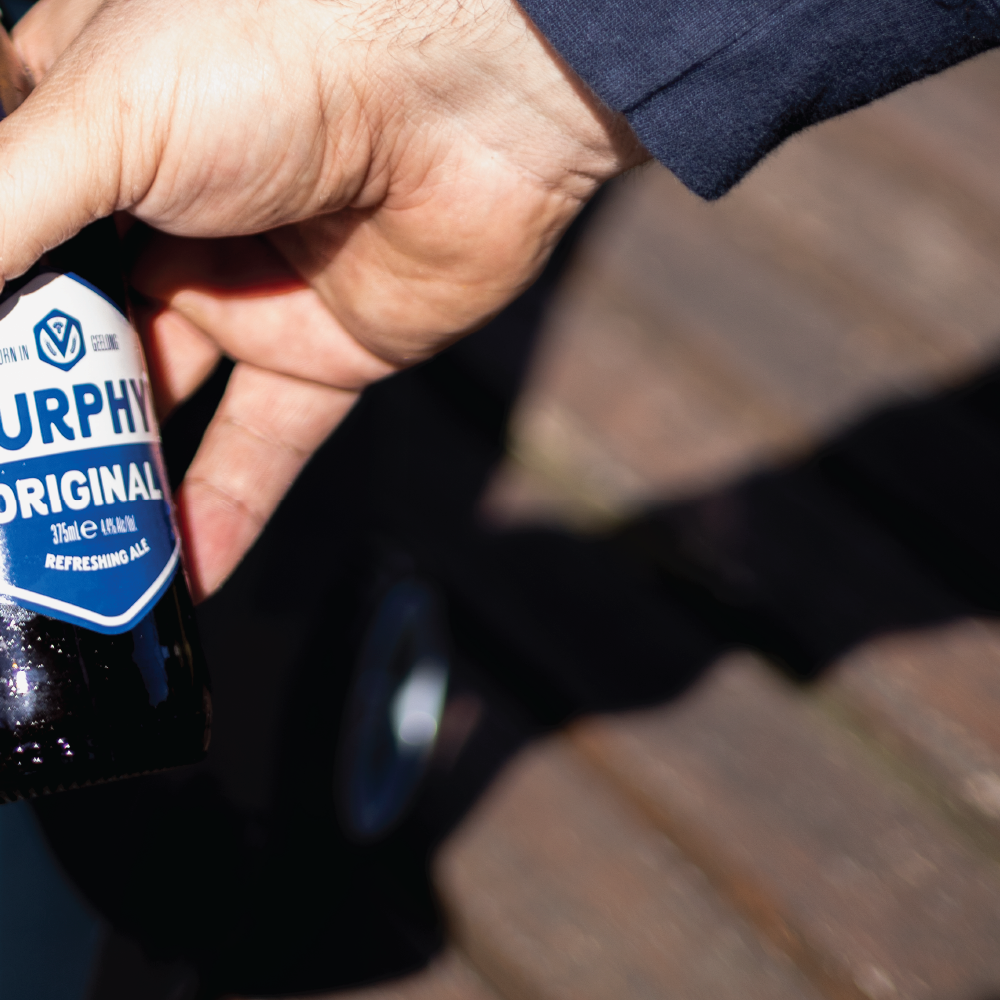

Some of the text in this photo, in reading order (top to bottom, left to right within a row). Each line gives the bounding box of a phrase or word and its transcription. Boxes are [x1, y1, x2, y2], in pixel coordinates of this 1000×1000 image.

[18, 344, 30, 361] IN
[90, 334, 119, 351] GEELONG
[44, 537, 151, 571] REFRESHING ALE
